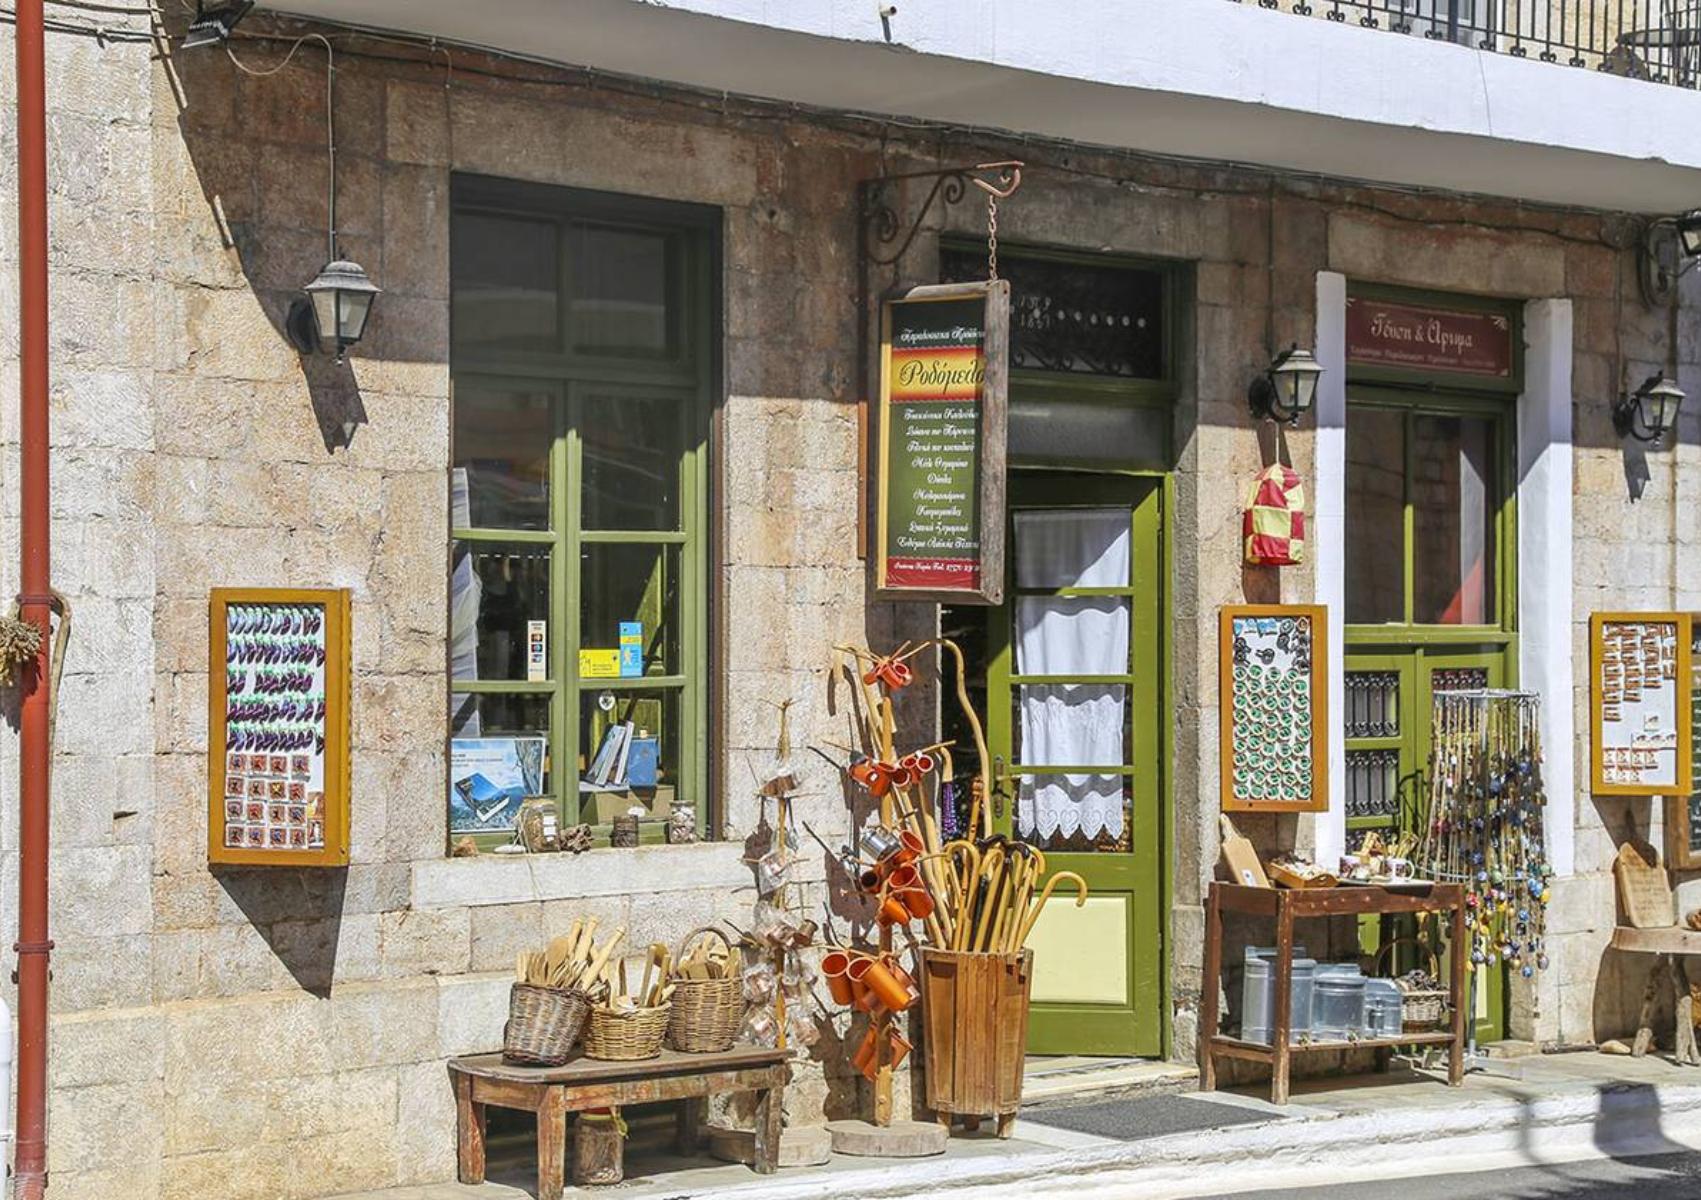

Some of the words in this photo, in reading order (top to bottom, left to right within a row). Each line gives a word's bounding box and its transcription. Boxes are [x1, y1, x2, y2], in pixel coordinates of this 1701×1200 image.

[1370, 313, 1412, 340] Γεύση
[1415, 325, 1424, 342] &
[1427, 317, 1473, 355] Άρωμα
